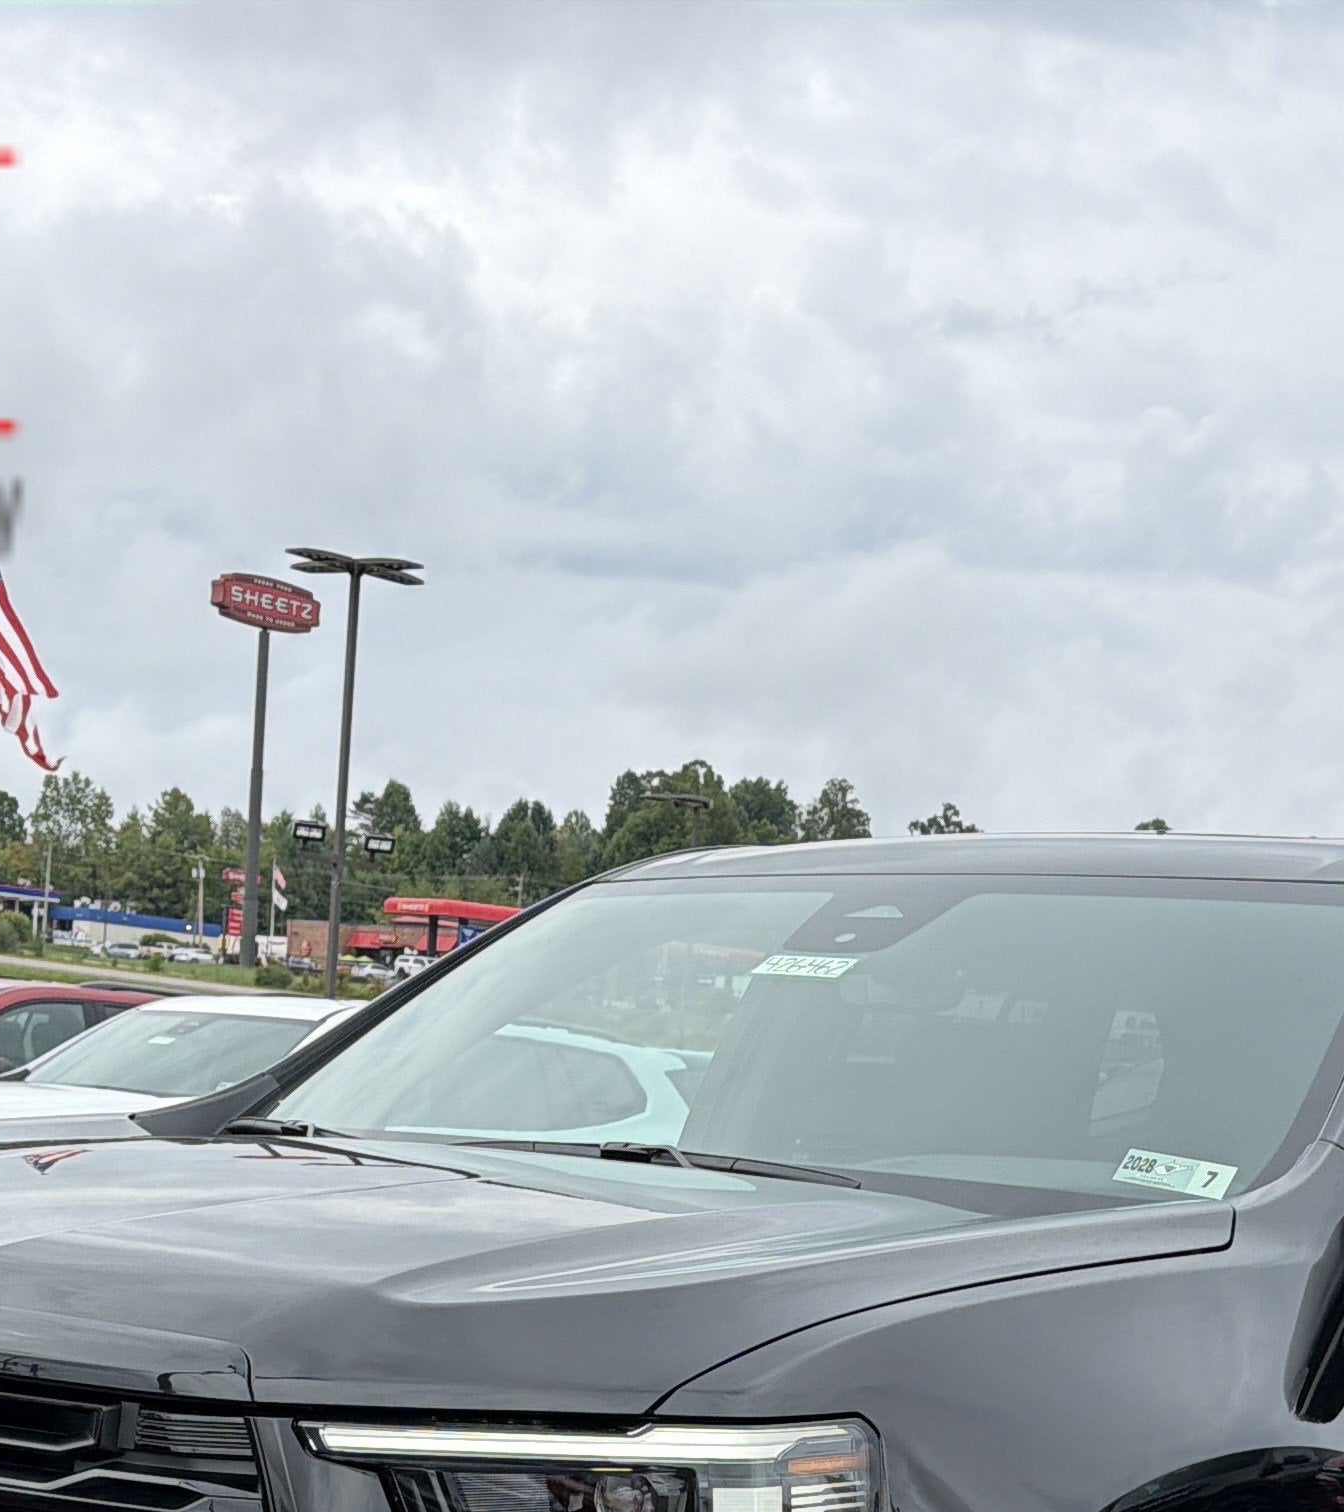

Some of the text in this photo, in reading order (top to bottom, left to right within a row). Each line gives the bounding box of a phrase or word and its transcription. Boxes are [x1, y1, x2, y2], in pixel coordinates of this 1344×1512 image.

[230, 585, 313, 620] SHEETZ
[1122, 1155, 1158, 1174] 2028
[1201, 1170, 1219, 1189] 7
